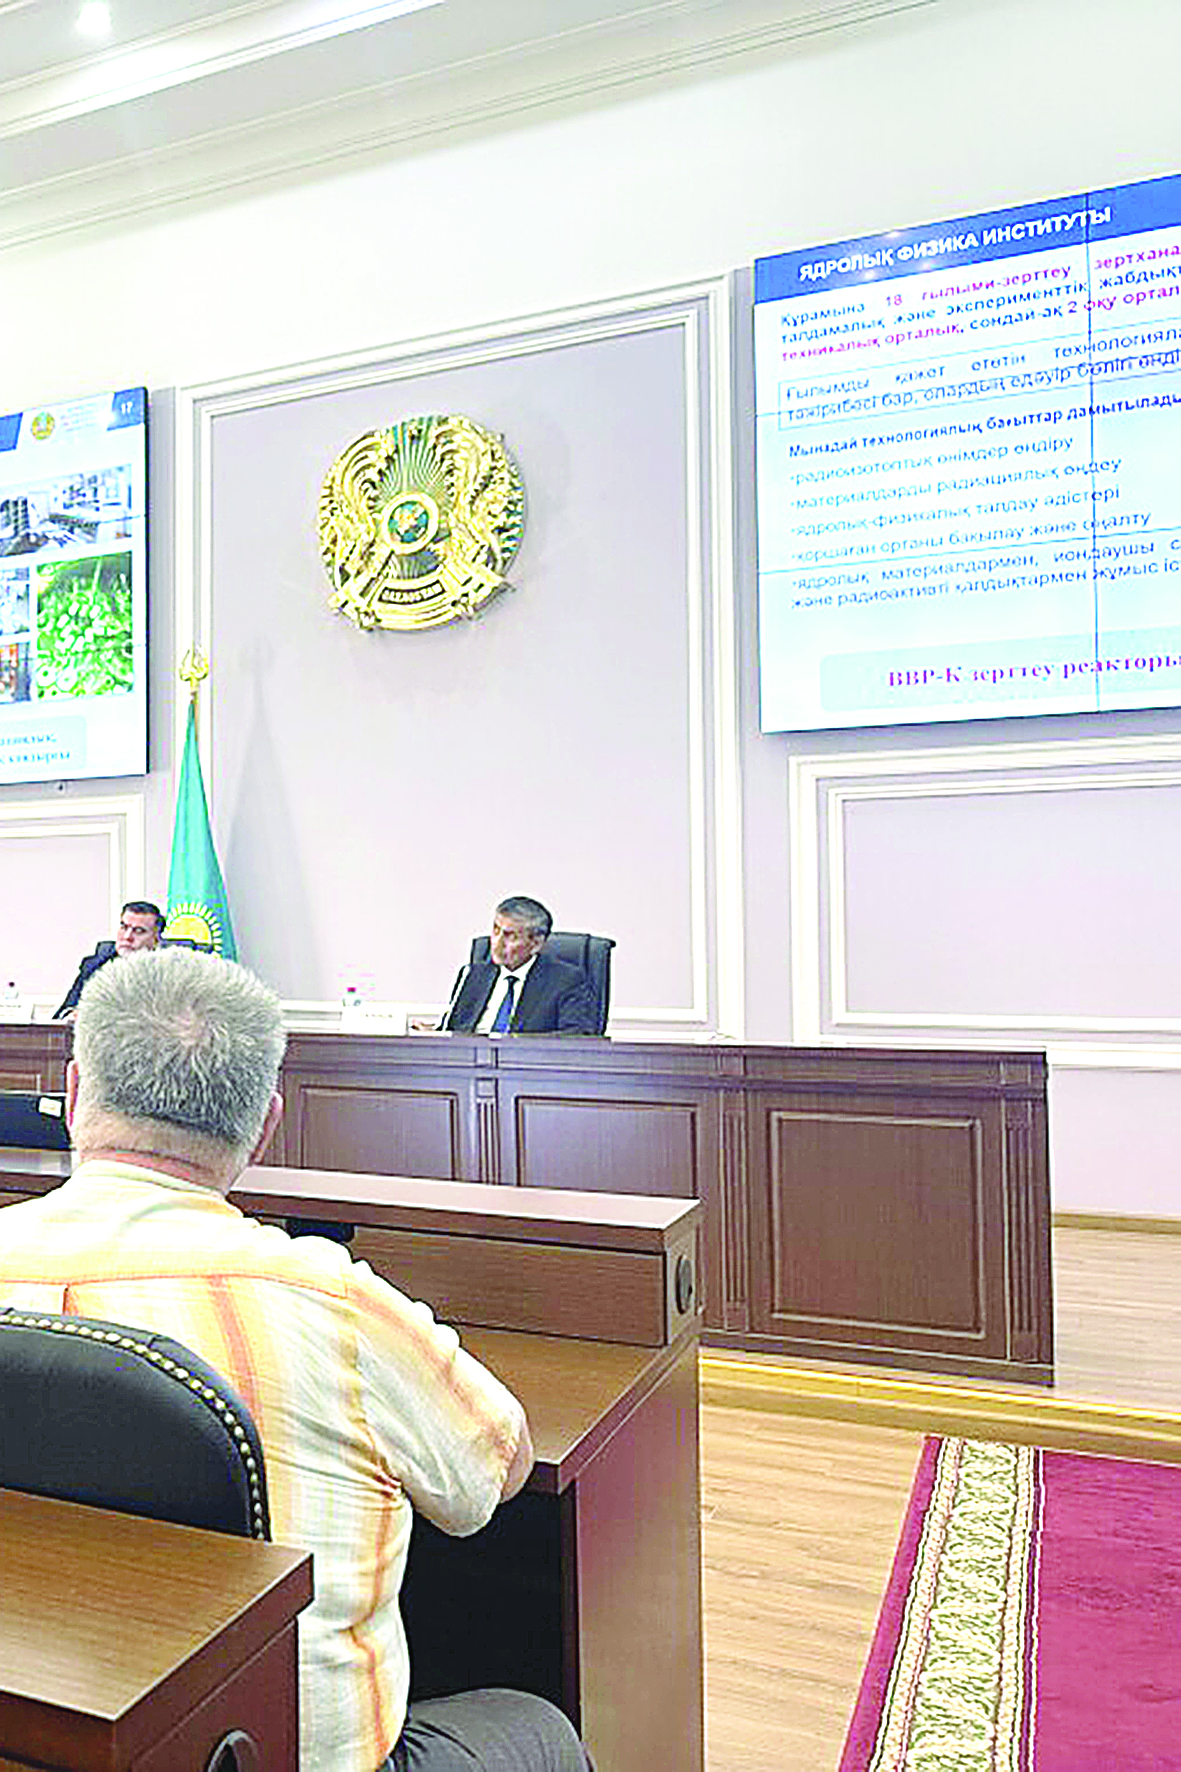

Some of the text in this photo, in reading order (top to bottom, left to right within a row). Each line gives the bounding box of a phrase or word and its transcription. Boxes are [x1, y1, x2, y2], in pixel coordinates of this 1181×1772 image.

[898, 233, 978, 260] ФИЗИКА
[983, 207, 1111, 244] ИНСТИТУТЫ
[886, 294, 903, 306] 18
[1067, 301, 1077, 314] 2
[889, 666, 962, 687] ВВР-К
